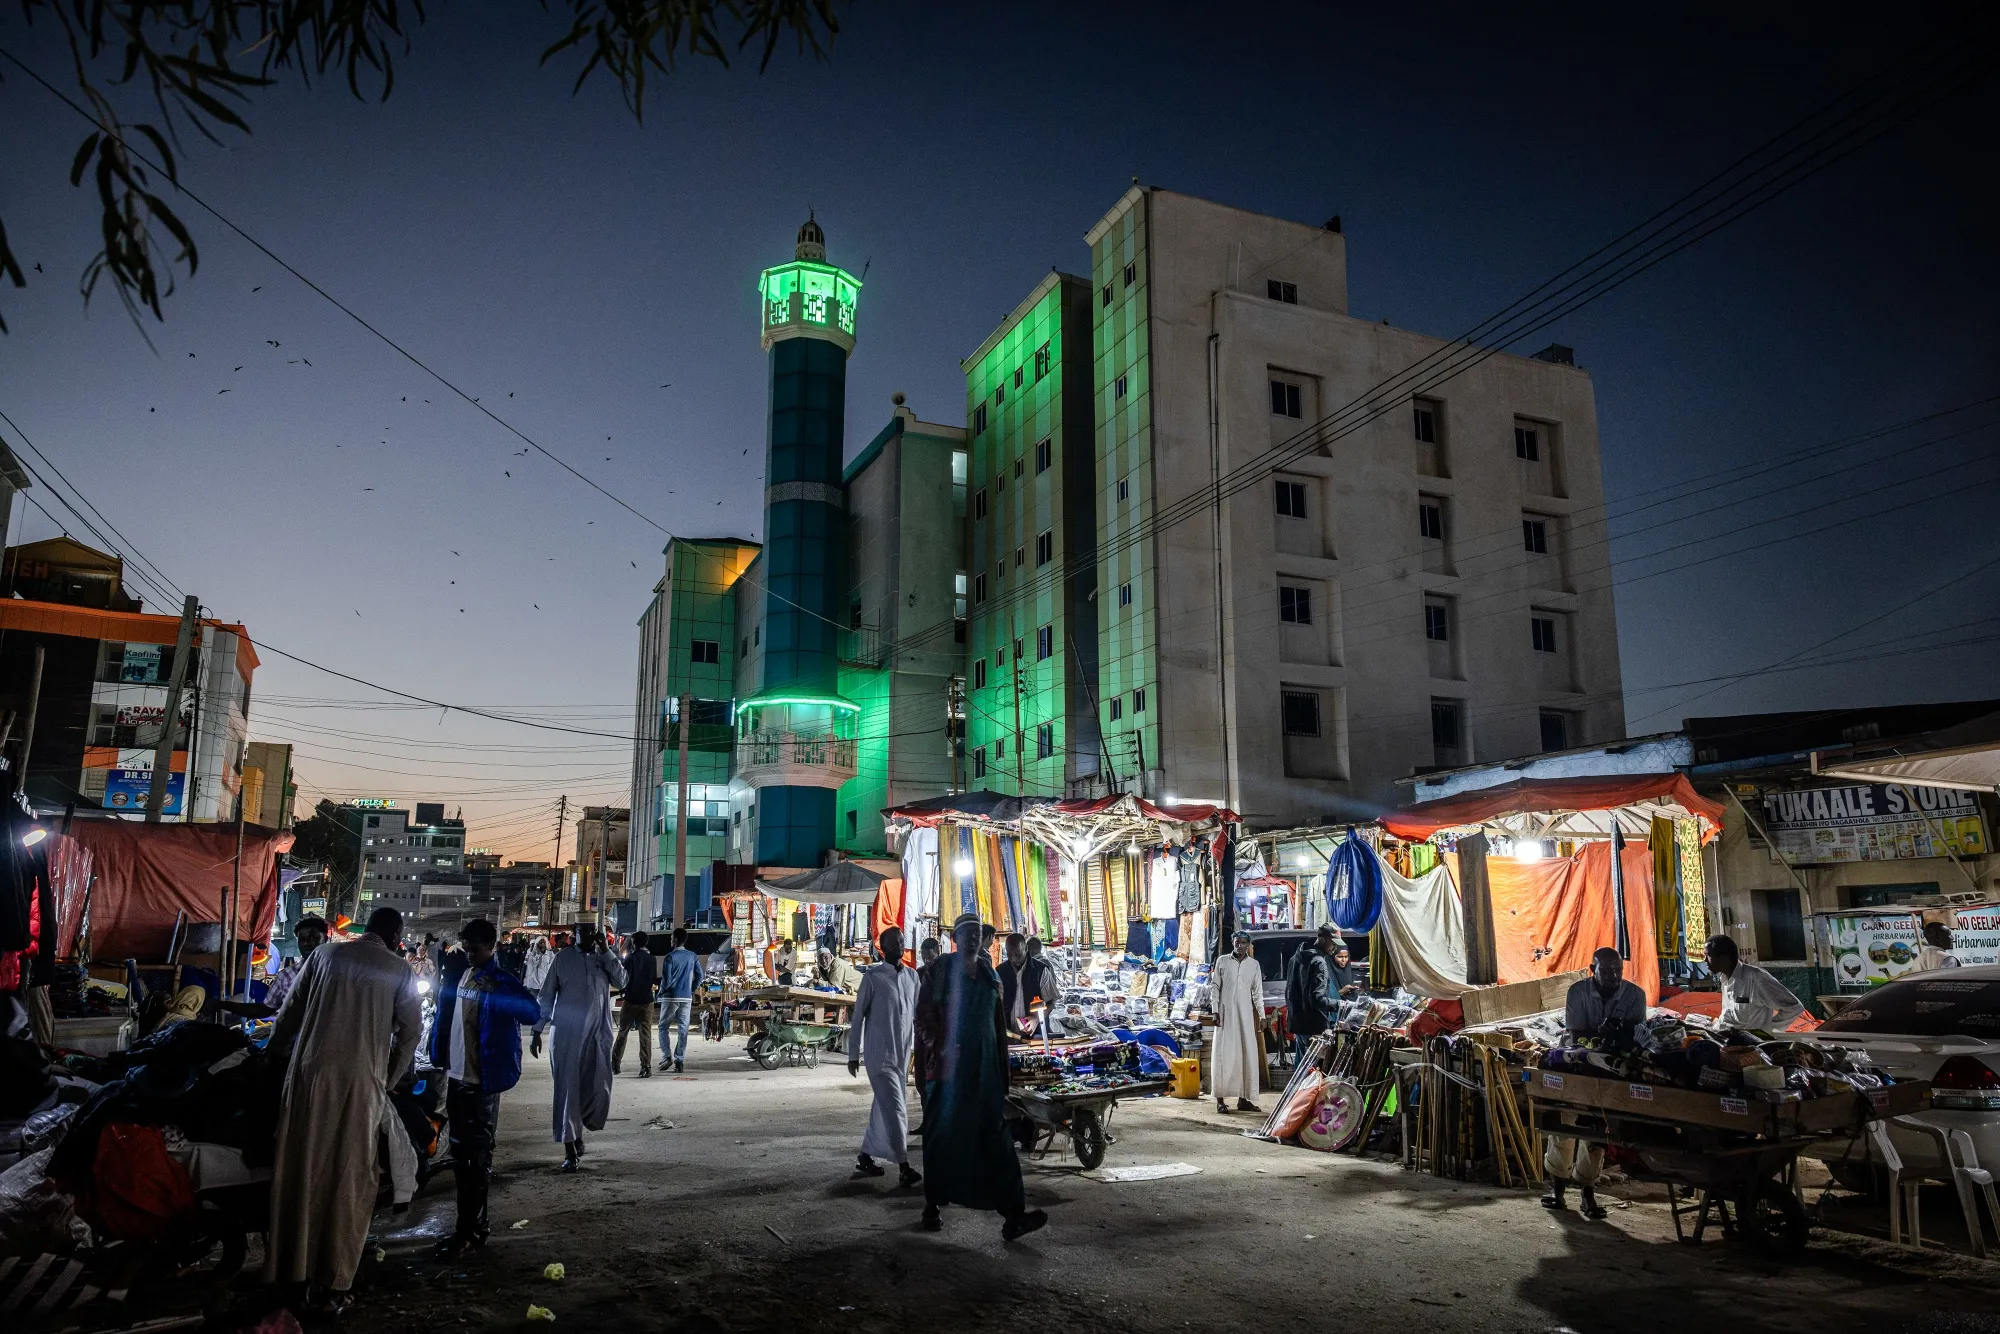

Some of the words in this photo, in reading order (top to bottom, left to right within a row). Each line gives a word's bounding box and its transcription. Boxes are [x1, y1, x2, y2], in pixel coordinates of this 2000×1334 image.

[1764, 786, 1876, 822] TUKAALE
[1885, 783, 1975, 814] STORE
[1861, 921, 1891, 931] CAANO
